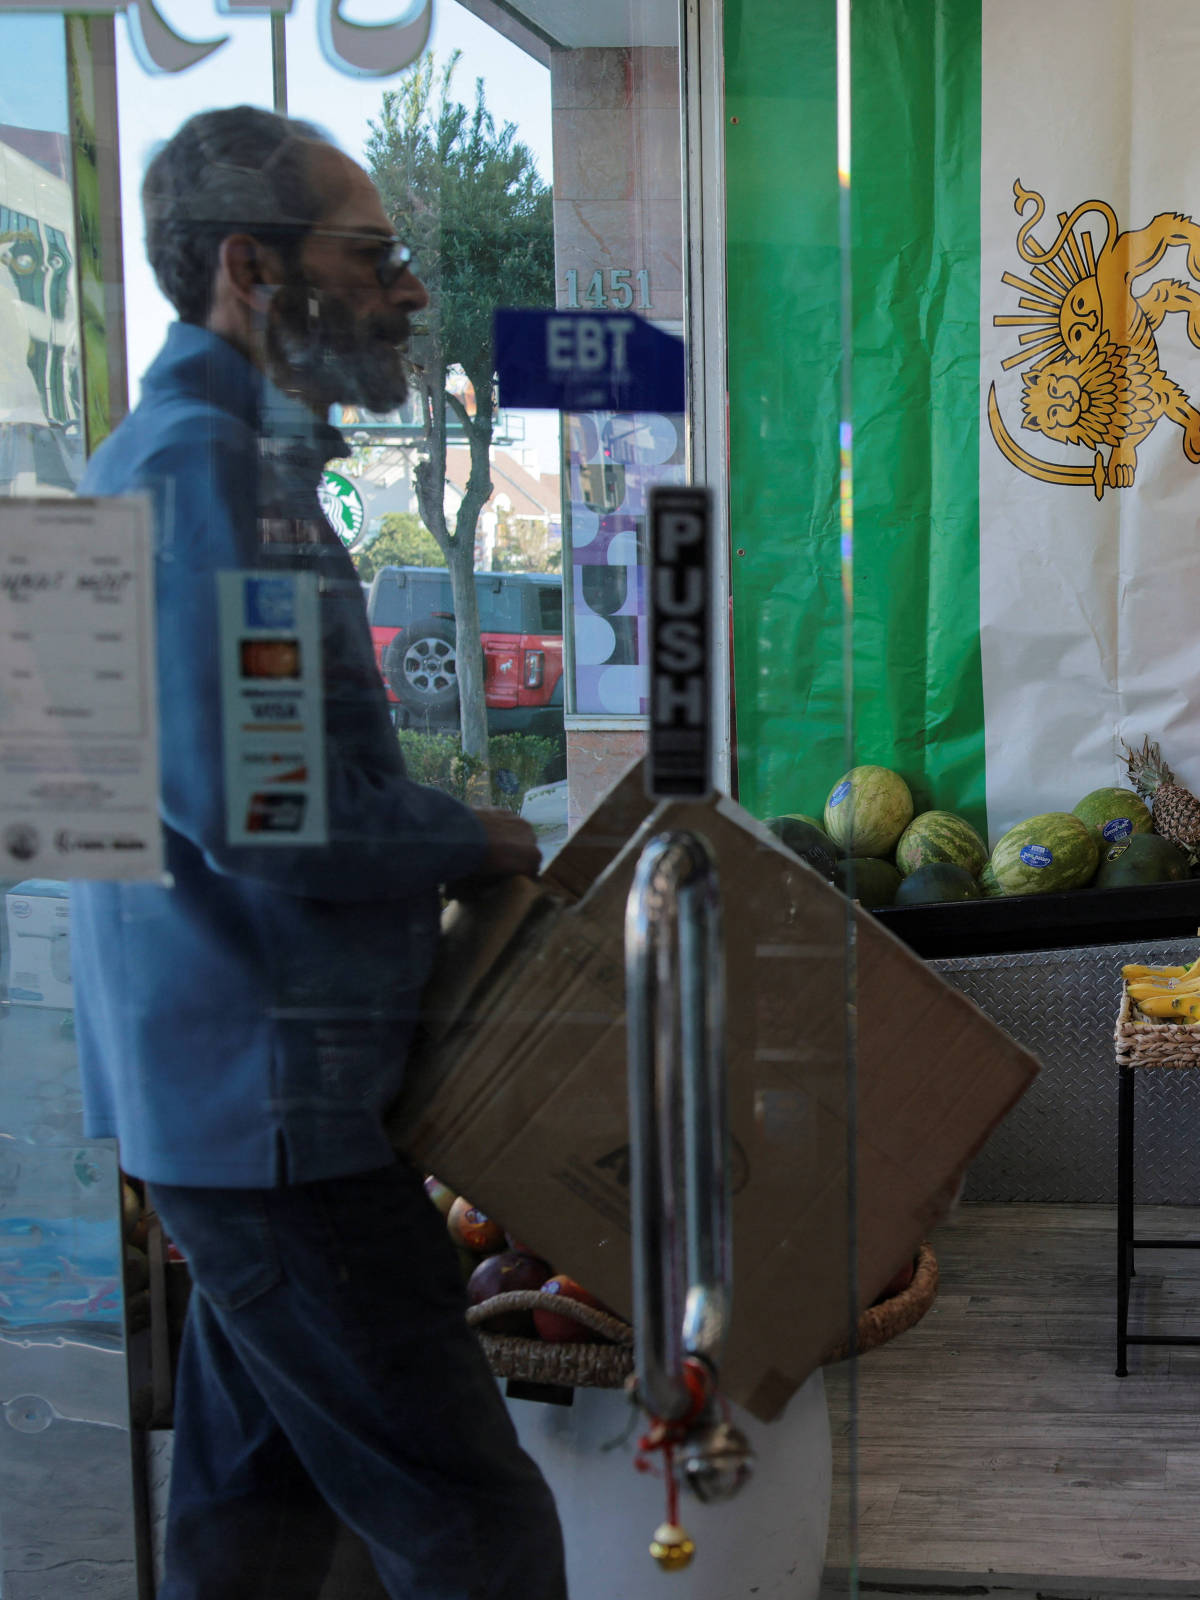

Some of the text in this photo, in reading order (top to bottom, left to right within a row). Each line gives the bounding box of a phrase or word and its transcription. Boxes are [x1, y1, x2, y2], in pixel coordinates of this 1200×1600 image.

[564, 269, 653, 310] 1451
[547, 318, 635, 369] EBT
[657, 512, 701, 724] PUSH
